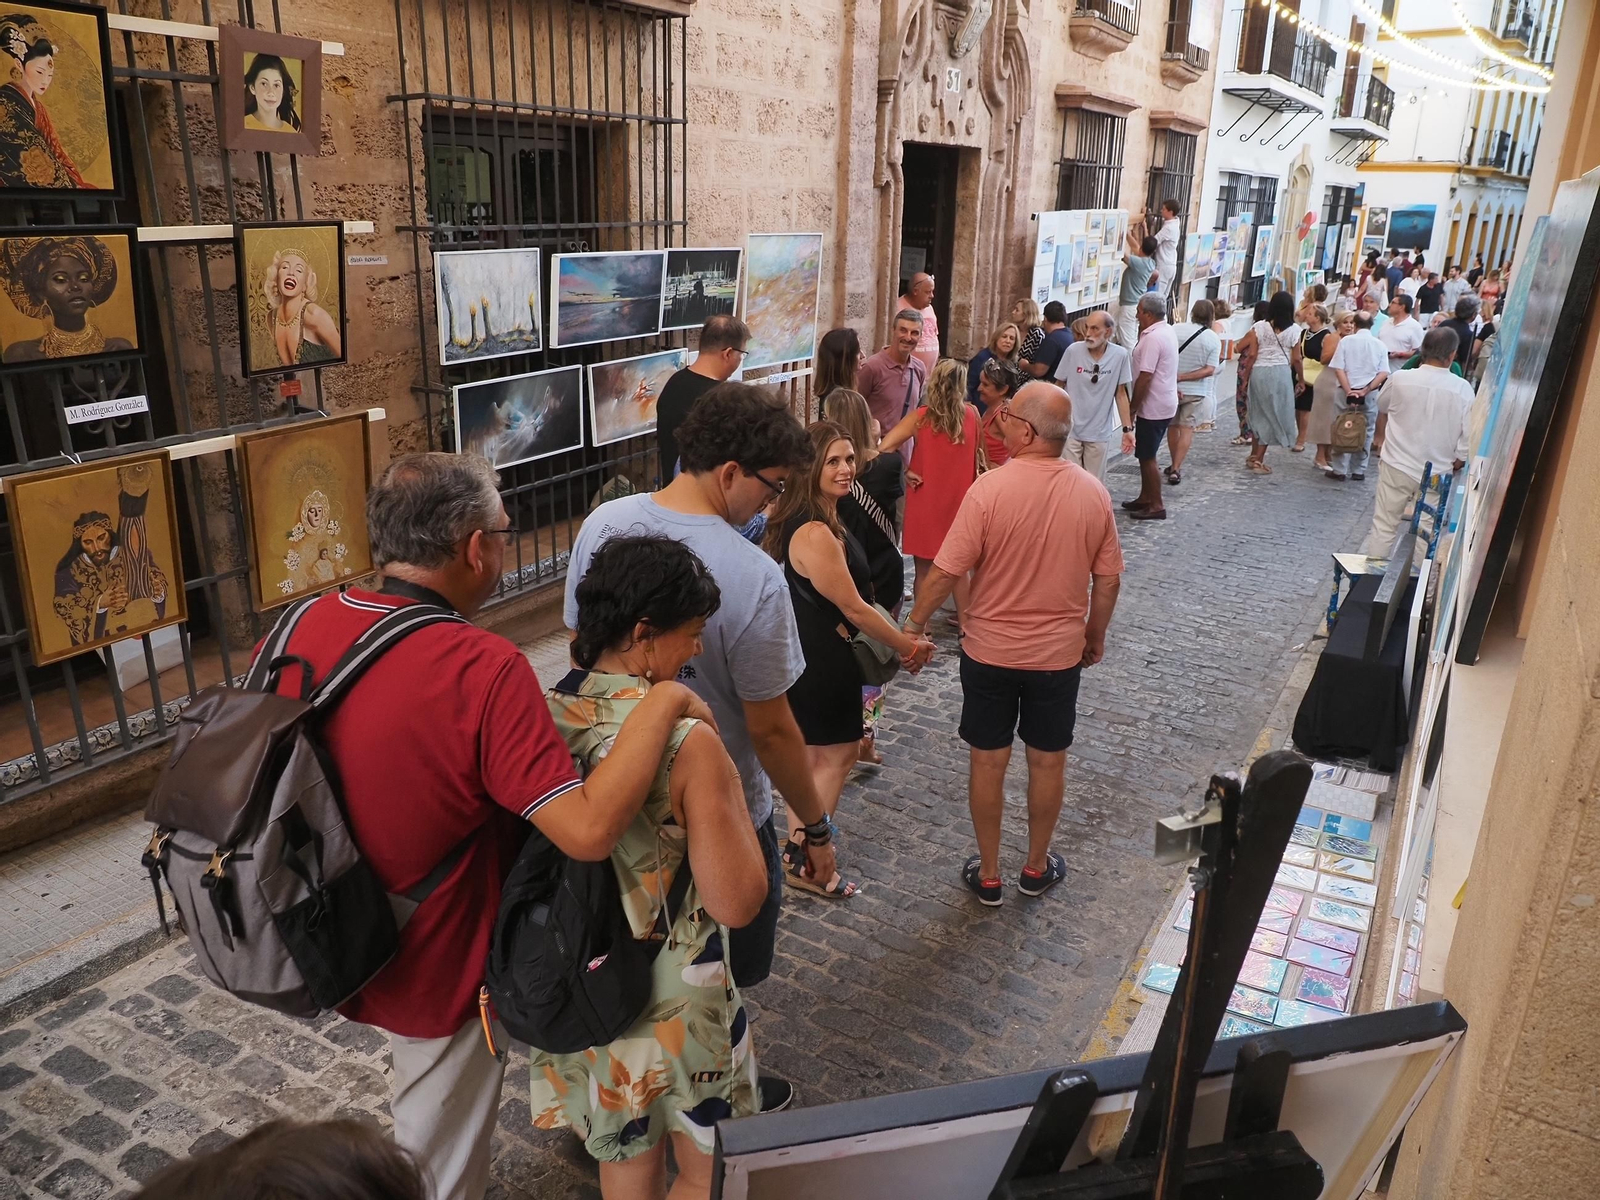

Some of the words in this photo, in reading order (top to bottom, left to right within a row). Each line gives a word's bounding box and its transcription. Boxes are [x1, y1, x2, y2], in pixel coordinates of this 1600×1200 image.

[69, 409, 81, 420] M.
[81, 404, 115, 418] Rodríguez
[115, 399, 145, 412] González
